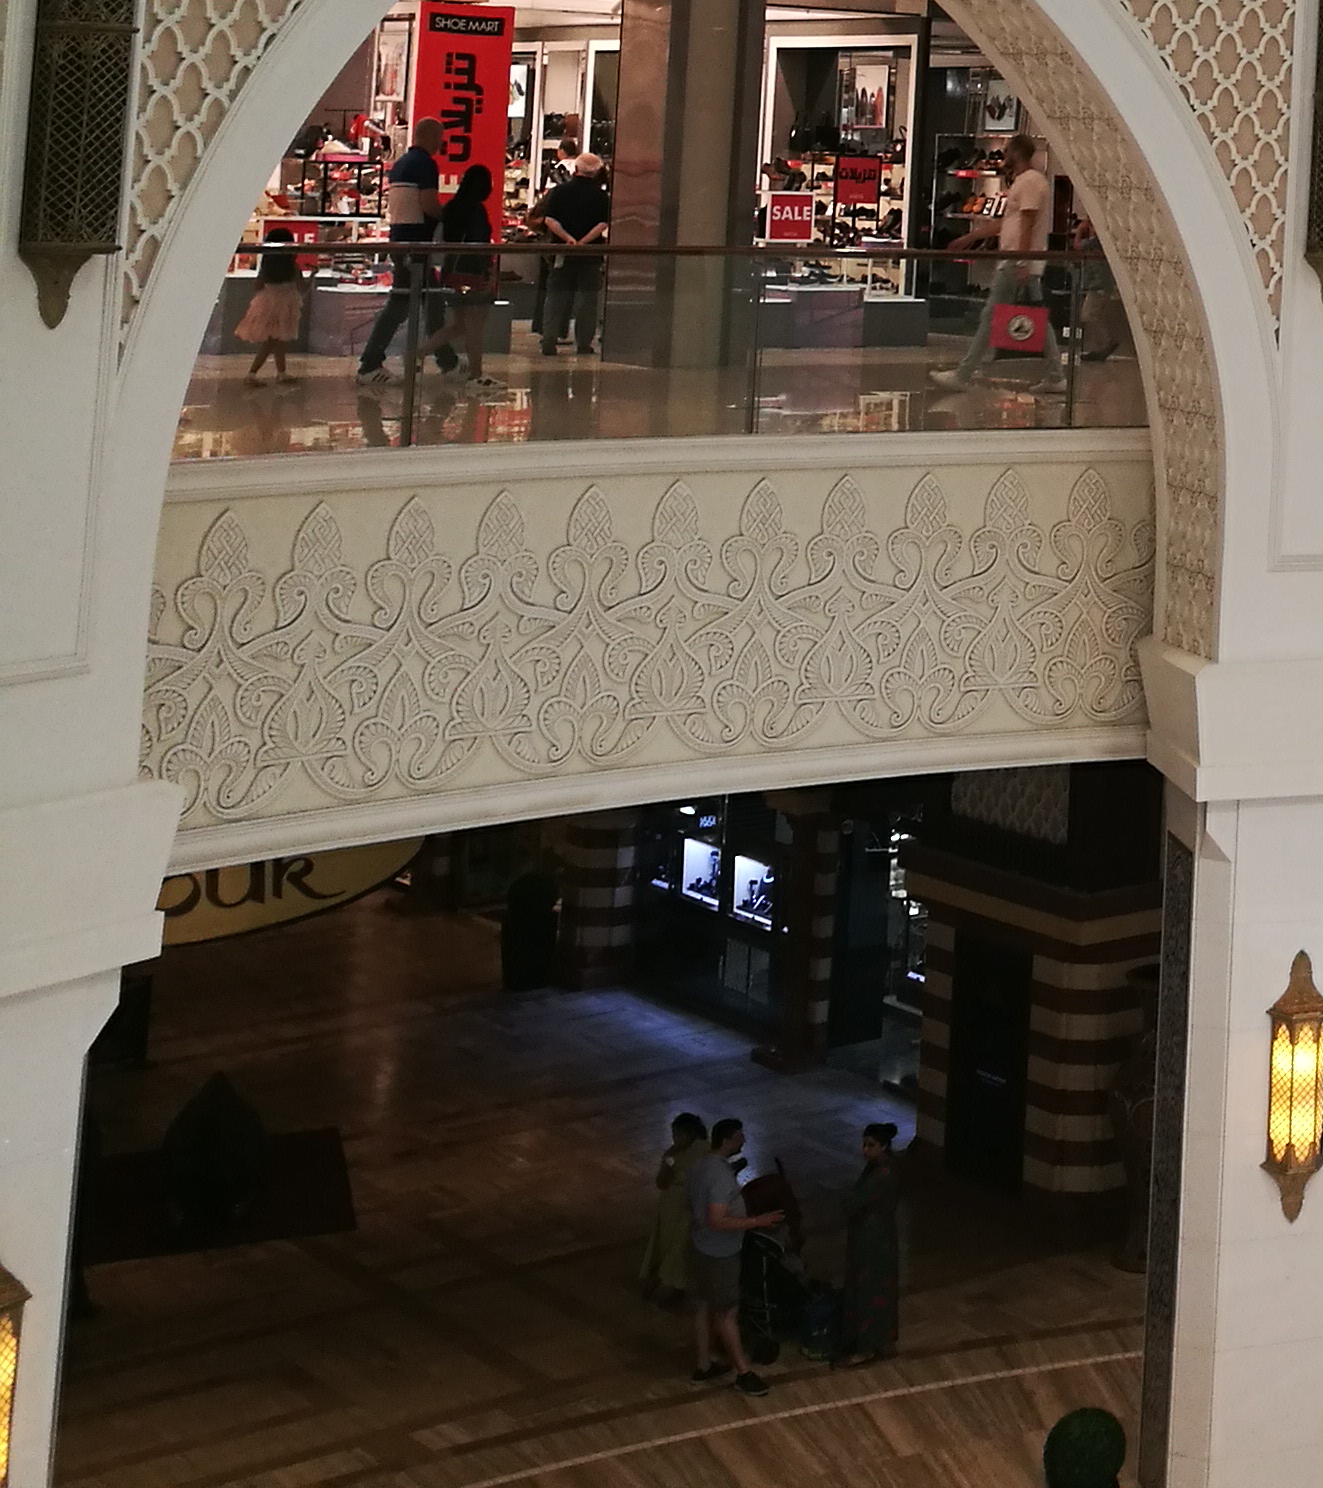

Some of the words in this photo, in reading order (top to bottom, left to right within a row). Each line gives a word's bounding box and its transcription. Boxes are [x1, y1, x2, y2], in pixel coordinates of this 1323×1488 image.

[435, 16, 467, 31] SHOE
[467, 19, 501, 33] MART
[771, 205, 812, 222] SALE
